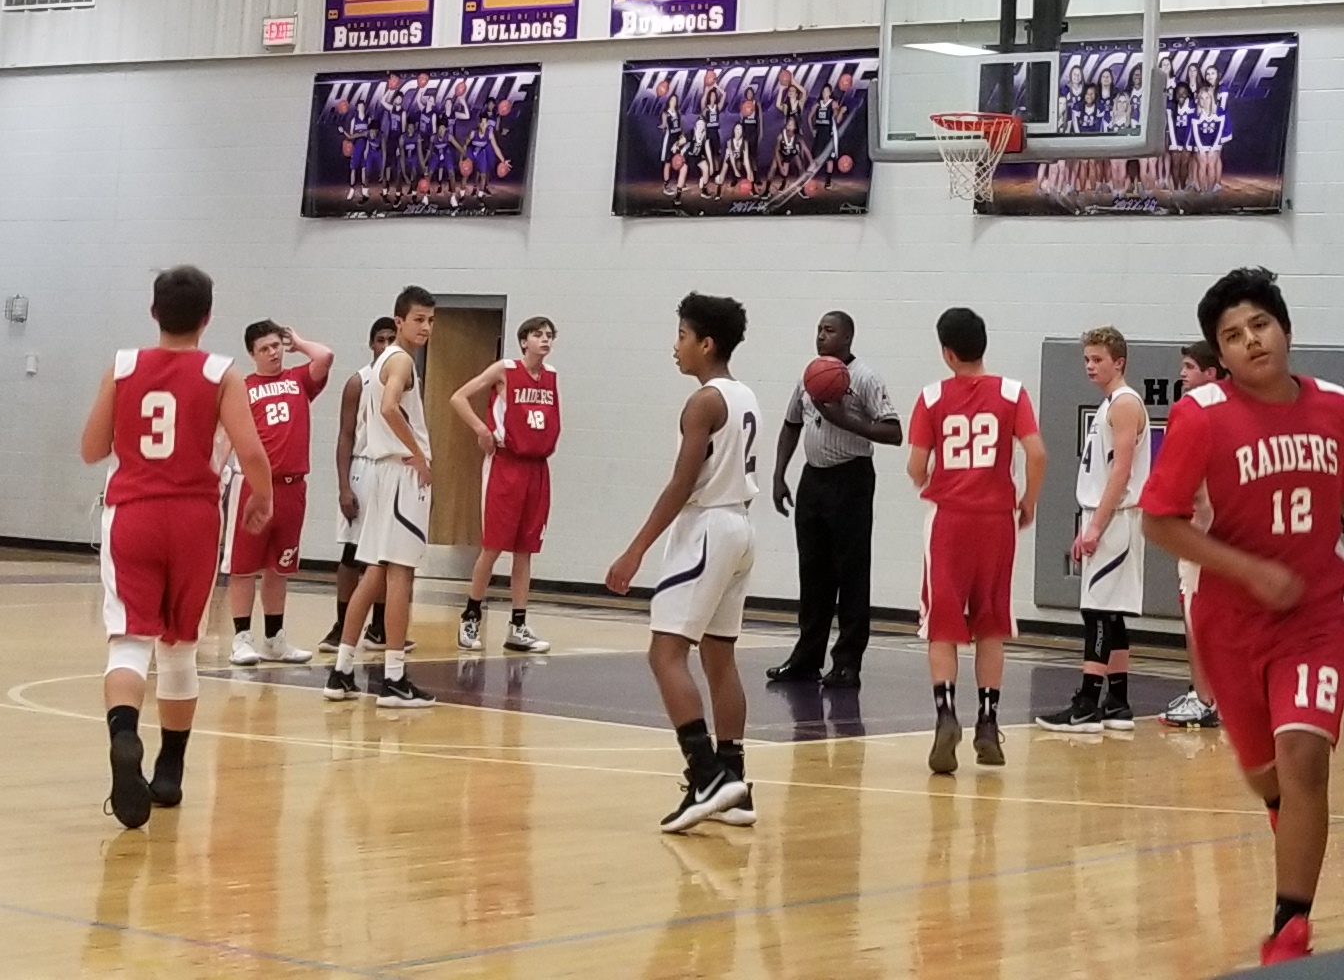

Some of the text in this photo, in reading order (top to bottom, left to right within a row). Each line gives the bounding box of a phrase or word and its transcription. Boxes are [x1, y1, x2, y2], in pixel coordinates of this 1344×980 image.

[333, 22, 422, 48] BULLDOGS
[471, 14, 566, 41] BULLDOGS
[248, 379, 300, 405] RAIDERS
[139, 390, 177, 460] 3
[265, 401, 289, 426] 23
[526, 409, 545, 430] 42
[942, 412, 999, 471] 22
[1235, 433, 1338, 486] RAIDERS
[1271, 486, 1313, 535] 12
[1294, 663, 1338, 714] 12
